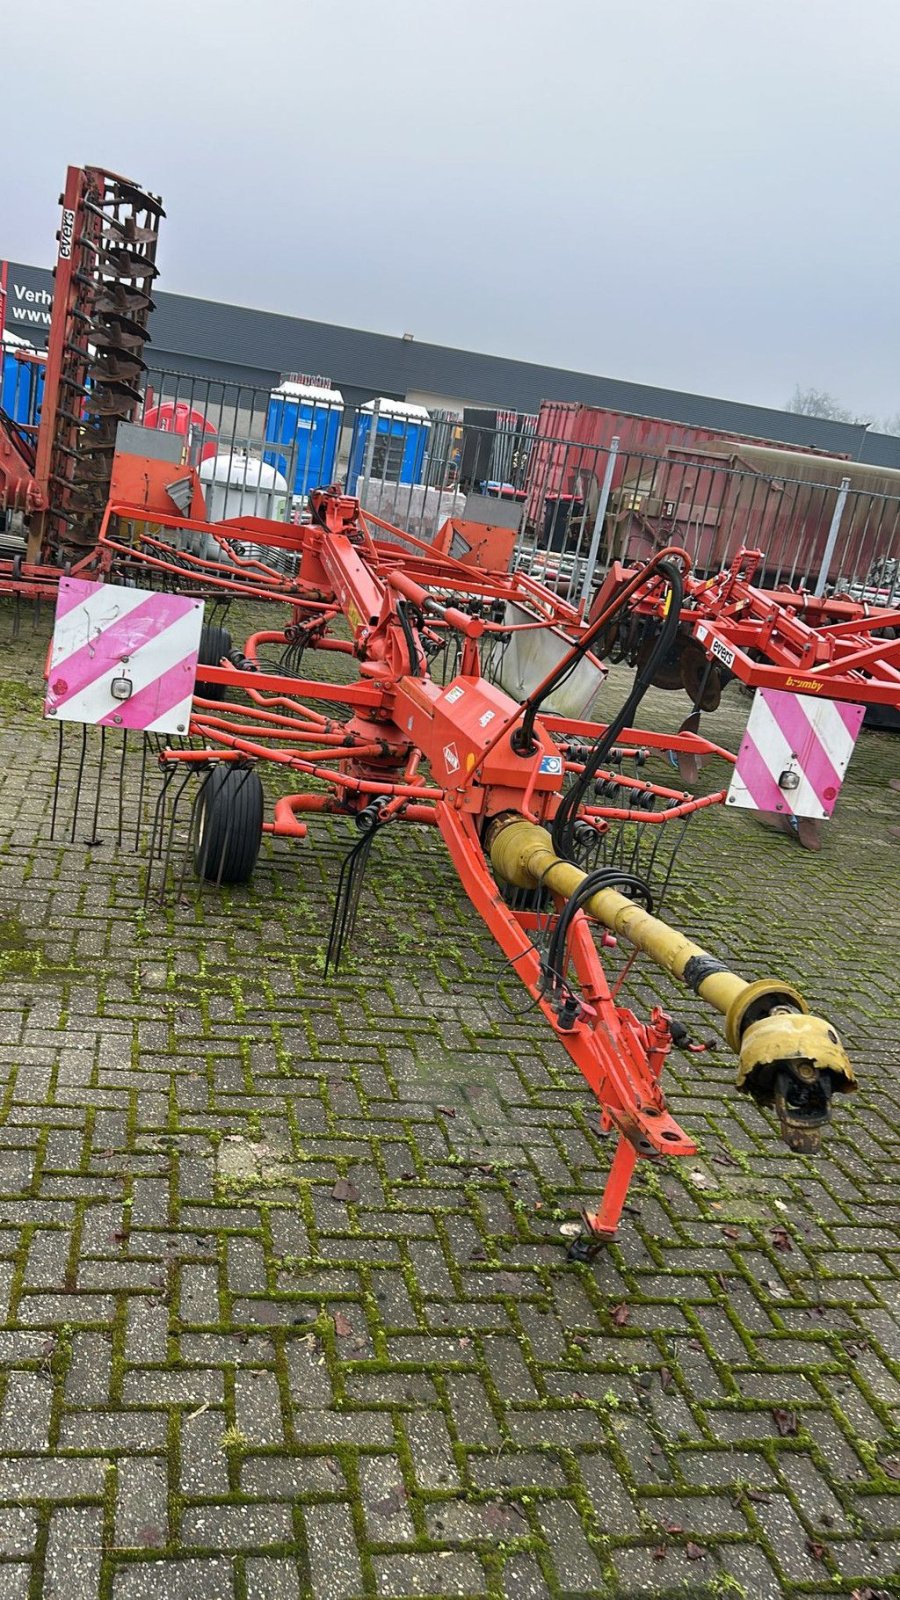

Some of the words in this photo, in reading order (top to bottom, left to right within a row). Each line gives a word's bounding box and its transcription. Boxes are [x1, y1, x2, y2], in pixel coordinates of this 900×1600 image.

[60, 211, 74, 257] evers
[14, 284, 54, 305] Verh
[712, 641, 733, 665] evers
